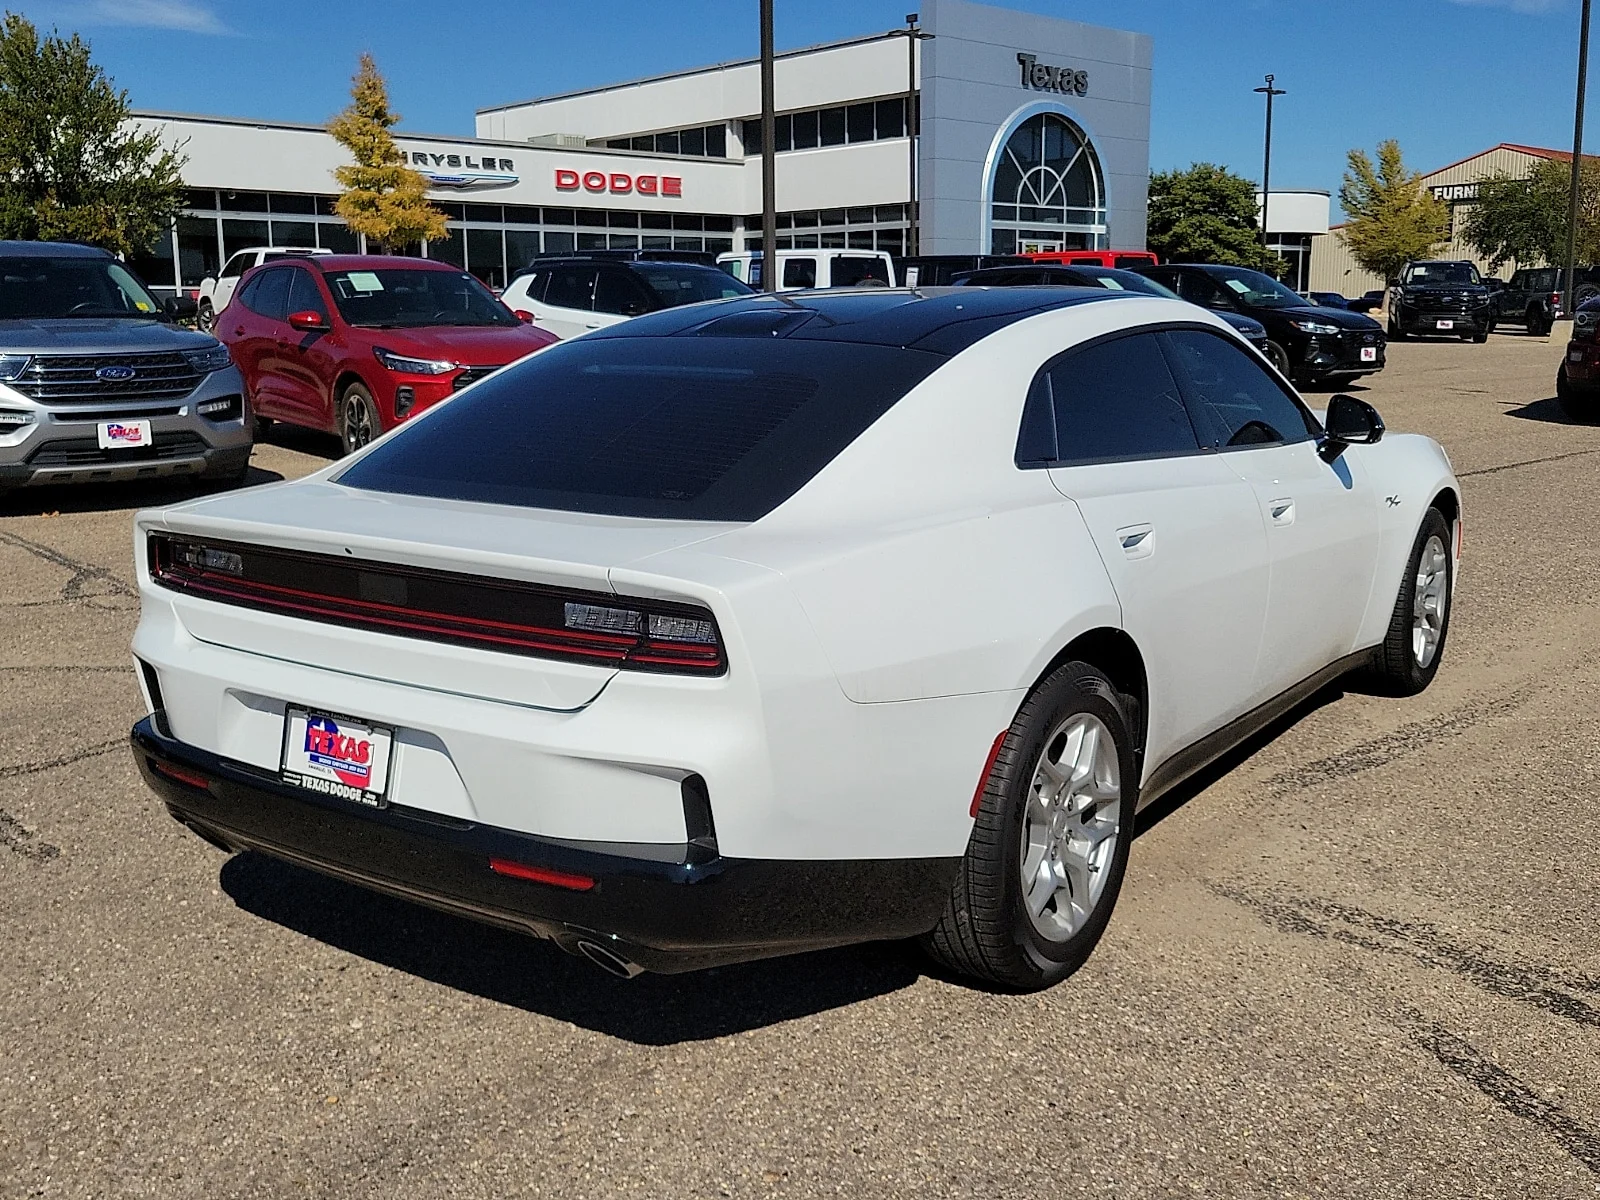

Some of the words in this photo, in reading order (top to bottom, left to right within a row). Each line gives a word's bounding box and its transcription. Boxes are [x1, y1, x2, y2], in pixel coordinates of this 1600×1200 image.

[1017, 53, 1088, 97] Texas
[400, 151, 516, 171] HRYSLER
[555, 169, 683, 197] DODGE
[1434, 185, 1479, 201] FURNI
[309, 728, 370, 763] TEXAS
[302, 775, 329, 792] TEXAS
[330, 783, 362, 801] DODGE
